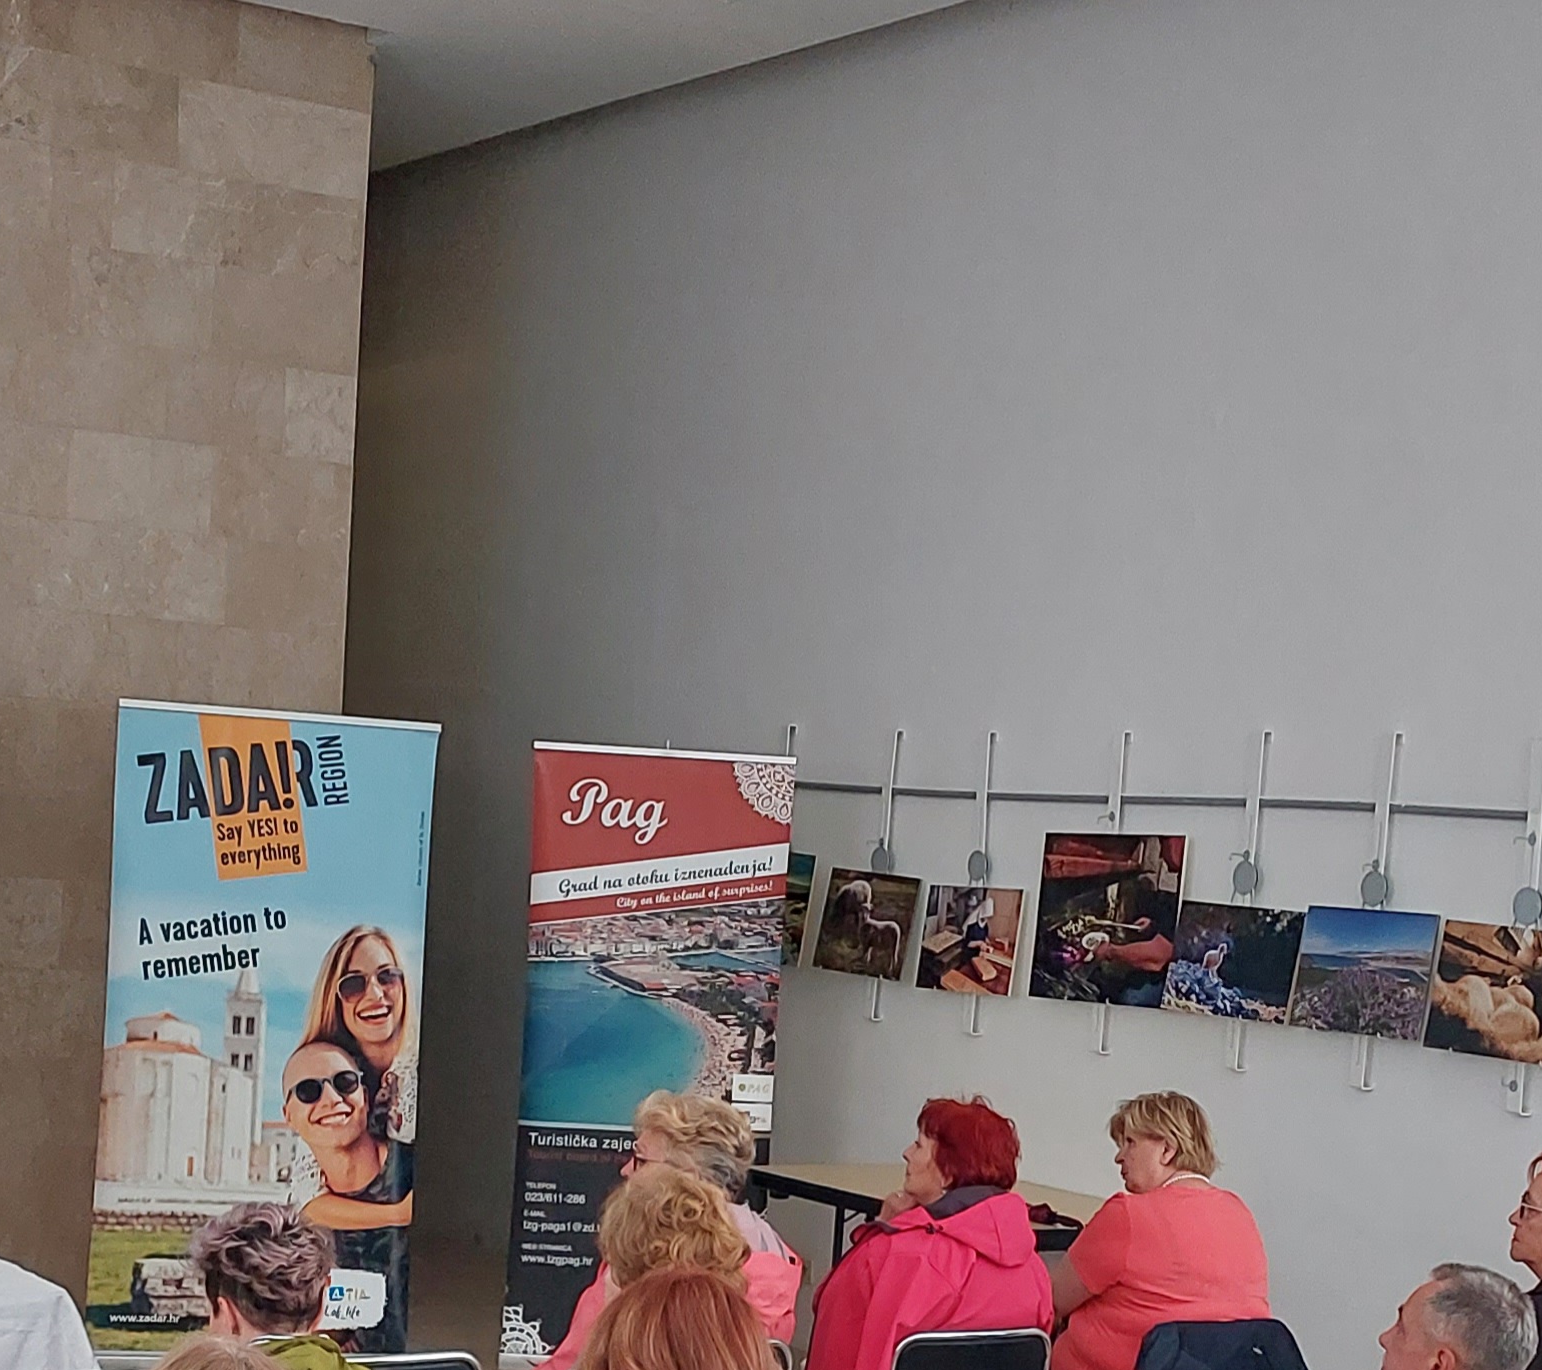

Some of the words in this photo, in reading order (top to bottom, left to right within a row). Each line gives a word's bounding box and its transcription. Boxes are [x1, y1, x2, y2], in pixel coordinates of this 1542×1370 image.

[315, 734, 350, 806] REGION
[561, 777, 668, 845] Pag
[216, 823, 243, 847] Say
[247, 817, 280, 839] YES!
[283, 818, 300, 834] to
[220, 843, 301, 870] everything
[558, 876, 599, 897] Grad
[602, 878, 623, 891] na
[627, 869, 671, 888] otoku
[616, 896, 638, 910] City
[640, 895, 654, 906] on
[655, 892, 672, 904] the
[673, 886, 706, 902] island
[707, 888, 721, 901] of
[721, 880, 774, 897] surprises!
[139, 916, 154, 946] A
[159, 910, 258, 943] vacation
[263, 907, 287, 931] to
[141, 943, 260, 981] remember
[528, 1132, 597, 1149] Turistička
[109, 1313, 180, 1324] www.zadar.hr
